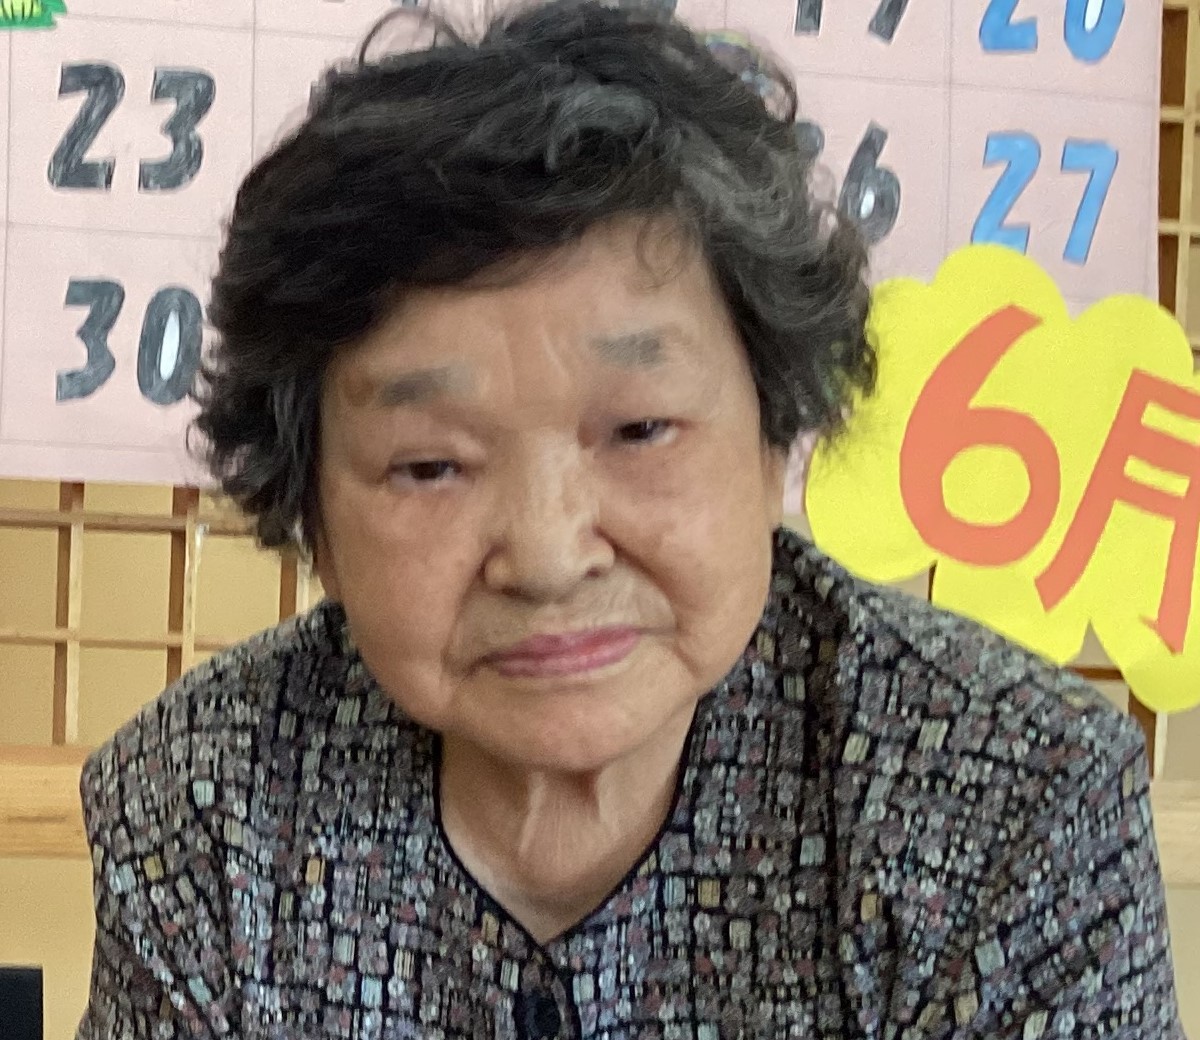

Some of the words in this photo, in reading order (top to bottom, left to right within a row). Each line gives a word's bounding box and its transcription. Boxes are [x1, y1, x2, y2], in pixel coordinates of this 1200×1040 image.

[47, 62, 216, 191] 23
[971, 131, 1118, 265] 27
[56, 277, 204, 405] 30
[899, 304, 1200, 655] 6月
